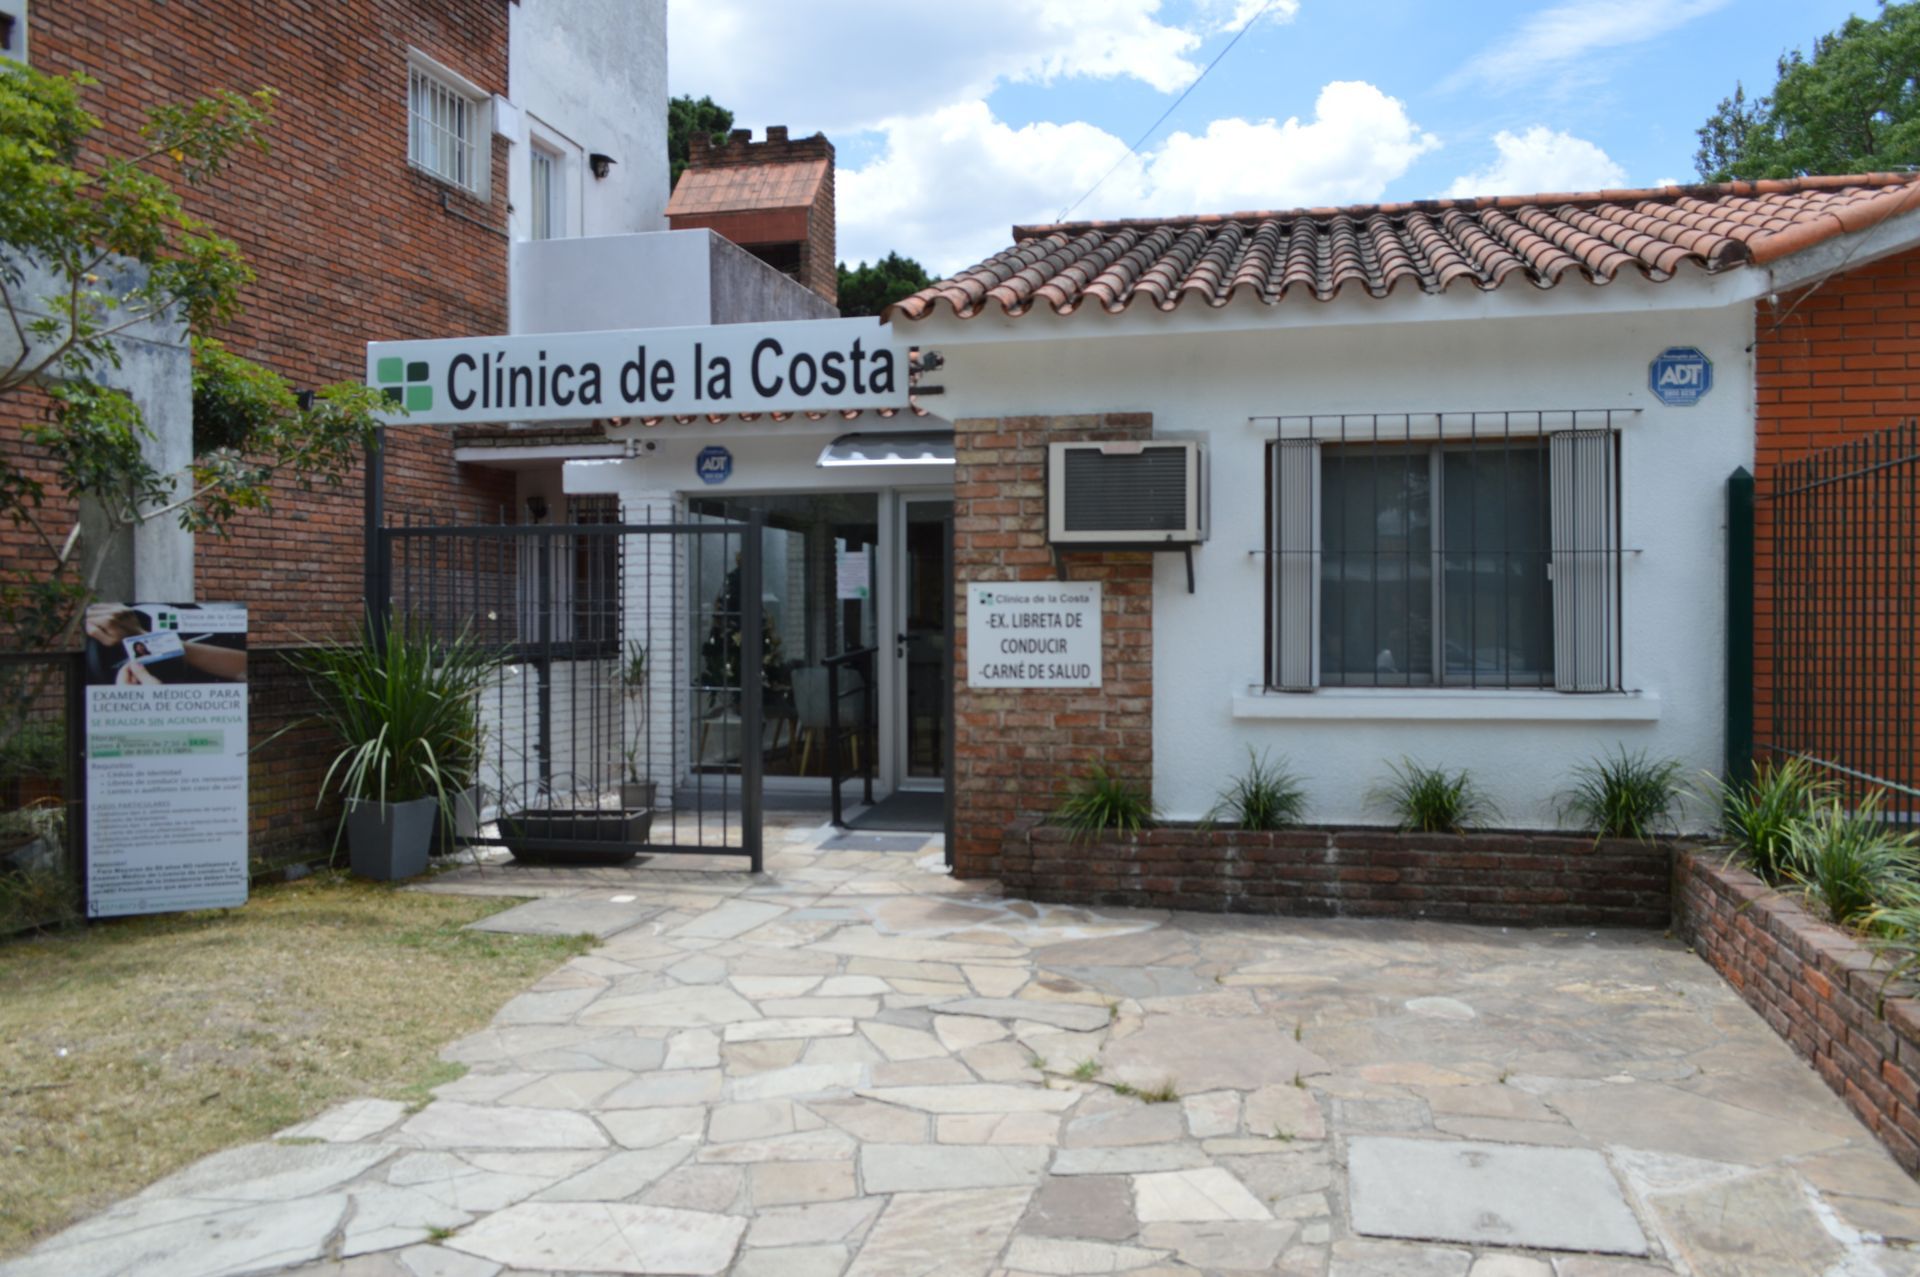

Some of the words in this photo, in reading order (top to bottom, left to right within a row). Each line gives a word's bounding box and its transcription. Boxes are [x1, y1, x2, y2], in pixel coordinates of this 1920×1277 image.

[447, 350, 602, 410] Clínica
[620, 345, 675, 403] de
[694, 343, 732, 400] la
[751, 336, 895, 398] Costa
[1659, 364, 1703, 385] ADT
[702, 456, 727, 471] ADT
[1032, 593, 1046, 604] de
[1048, 593, 1058, 604] la
[1060, 593, 1090, 604] Costa
[985, 613, 1009, 629] -EX.
[1012, 613, 1062, 629] LIBRETA
[1066, 613, 1083, 629] DE
[1000, 638, 1067, 654] CONDUCIR
[979, 660, 1025, 679] -CARNÉ
[1028, 663, 1045, 679] DE
[1048, 663, 1091, 679] SALUD
[92, 690, 145, 701] EXAMEN
[152, 688, 202, 700] MÉDICO
[209, 689, 241, 699] PARA
[92, 701, 151, 713] LICENCIA
[155, 701, 170, 712] DE
[175, 700, 241, 712] CONDUCIR
[91, 718, 102, 727] SE
[105, 717, 145, 727] REALIZA
[148, 717, 165, 727] SIN
[168, 716, 207, 725] AGENDA
[210, 715, 243, 724] PREVIA
